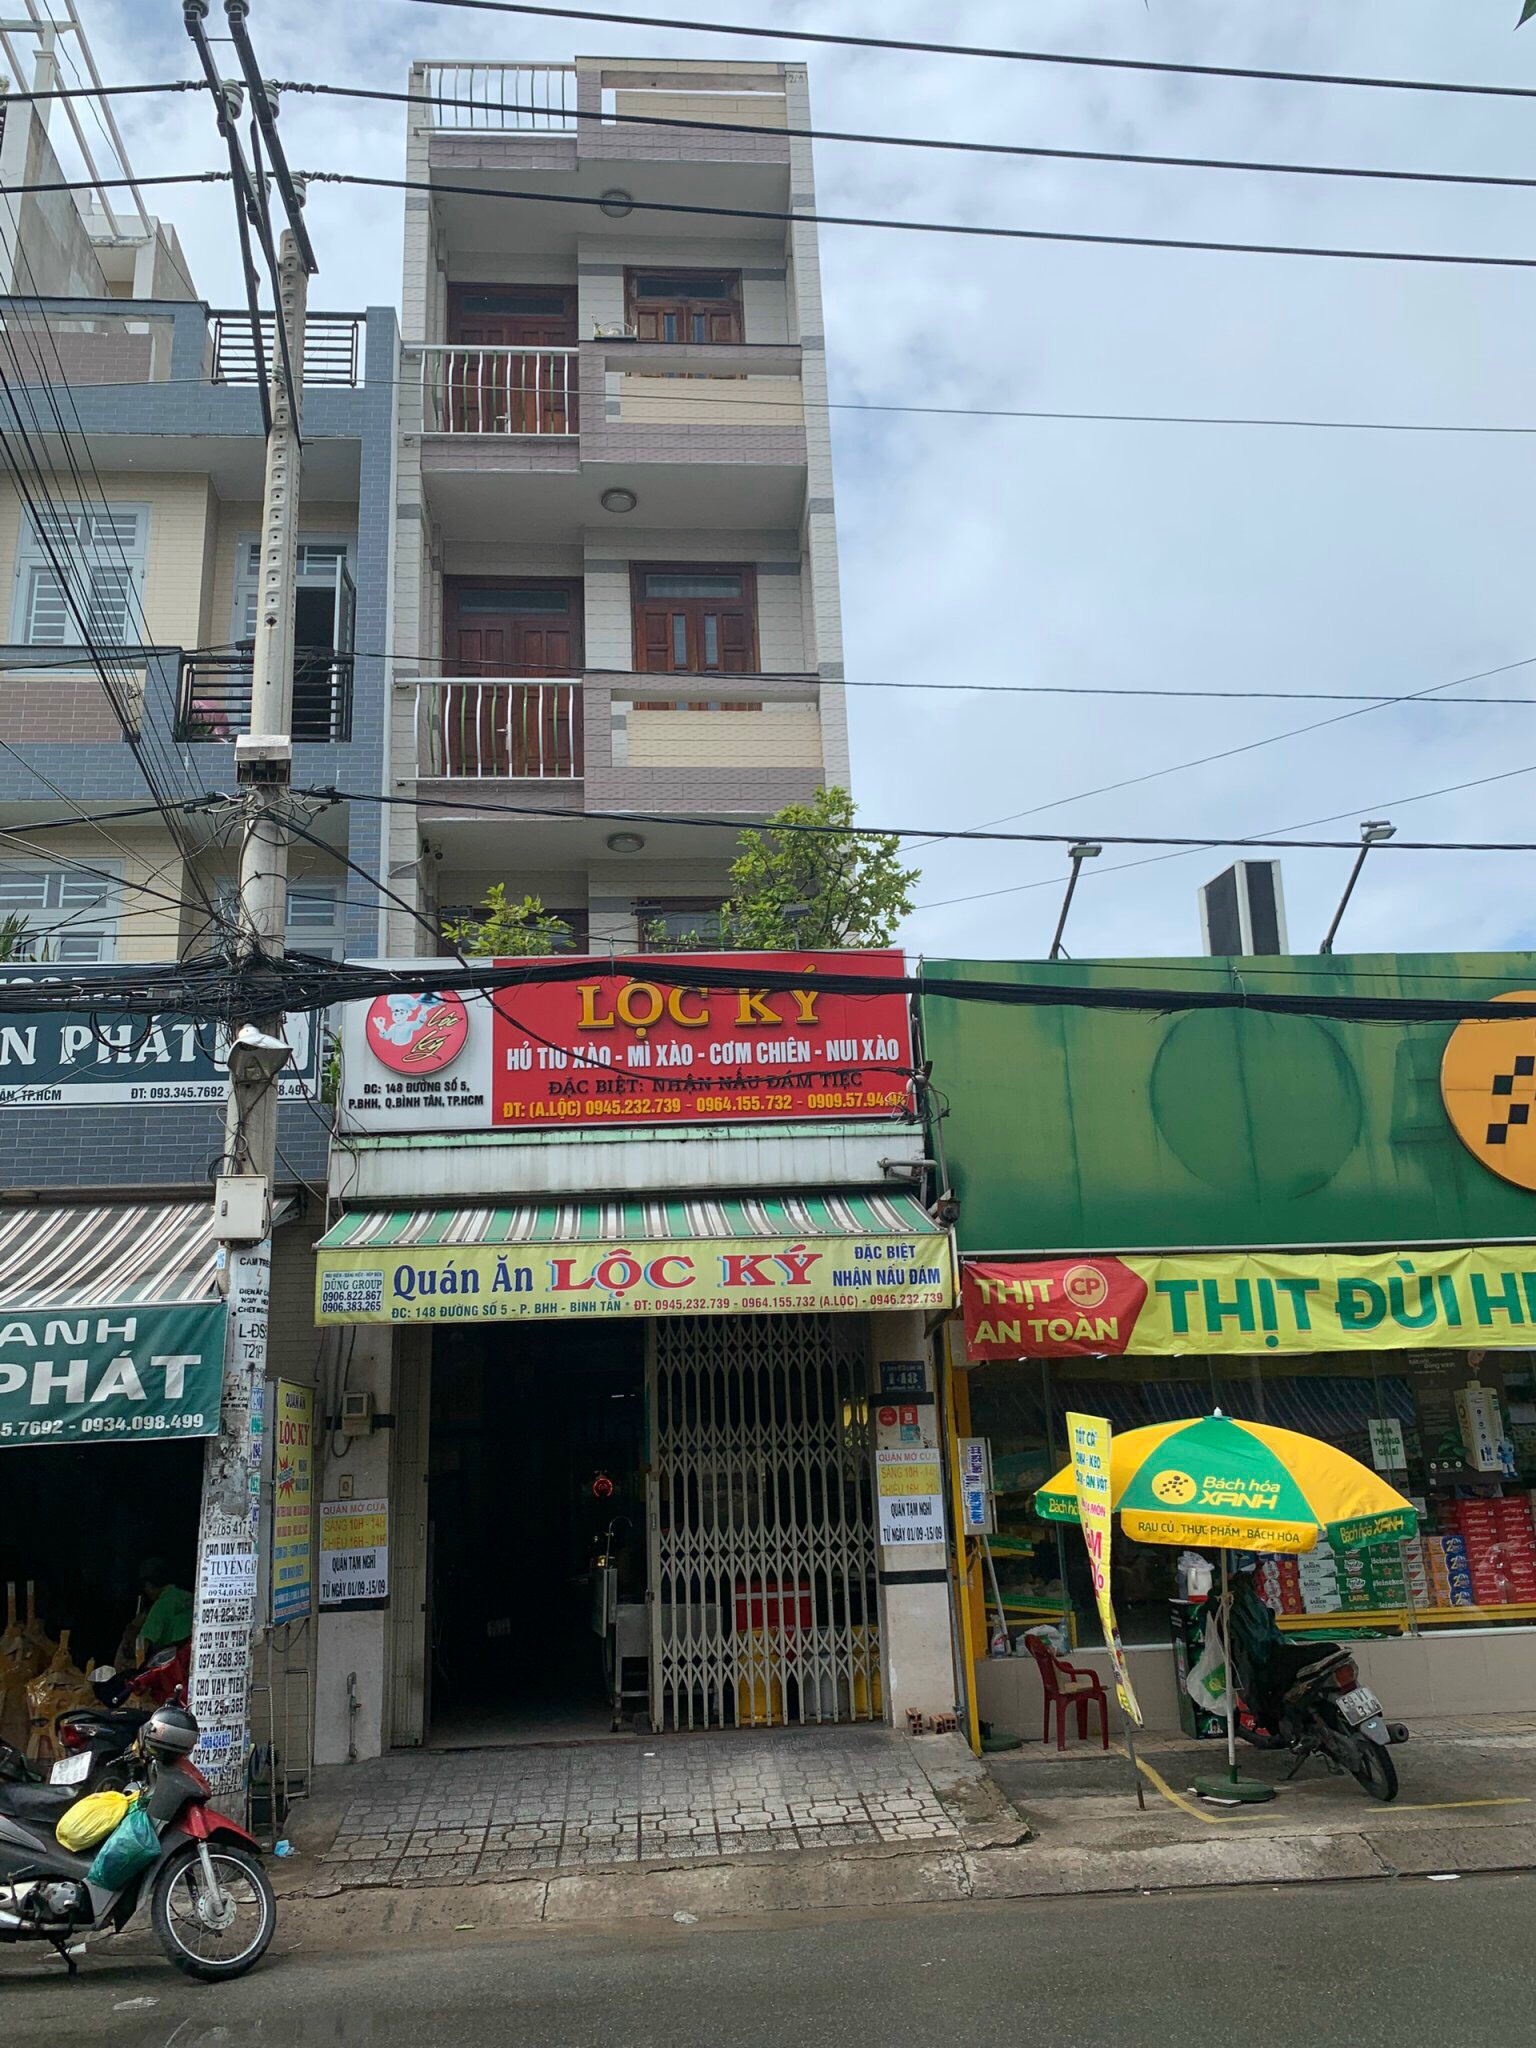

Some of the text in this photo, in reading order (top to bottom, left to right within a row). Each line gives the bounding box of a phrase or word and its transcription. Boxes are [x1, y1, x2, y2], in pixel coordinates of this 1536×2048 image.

[576, 964, 819, 1039] LỘC KÝ
[507, 1041, 532, 1071] HỦ
[572, 1041, 611, 1068] XÀO
[628, 1041, 650, 1067] MÌ
[656, 1039, 693, 1066] XÀO
[710, 1039, 752, 1065] CƠM
[757, 1036, 811, 1063] CHIÊN
[826, 1039, 859, 1062] NUI
[862, 1034, 899, 1061] XÀO
[21, 1089, 62, 1102] TP.HCM
[131, 1085, 224, 1100] ĐT: 093.345.7692
[385, 1082, 403, 1095] 148
[548, 1078, 588, 1098] ĐẶC
[446, 1093, 484, 1107] TP.HCM
[503, 1091, 907, 1121] ĐT: (A.LỘC) 0945.232.739 0964.155.732 0909.57.94.9
[854, 1242, 917, 1263] ĐẶC BIỆT
[392, 1243, 824, 1301] Quán Ăn LỘC KÝ
[832, 1262, 941, 1290] NHẬN NẤU ĐÁM
[352, 1279, 383, 1290] GROUP
[974, 1278, 1054, 1311] THỊT
[1070, 1277, 1100, 1296] CP
[323, 1290, 382, 1302] 0906.822.867
[391, 1307, 411, 1319] ĐC:
[415, 1306, 436, 1318] 148
[439, 1303, 479, 1318] ĐƯỜNG
[482, 1300, 497, 1316] SỐ
[500, 1304, 508, 1316] 5
[534, 1302, 558, 1314] BHH
[569, 1298, 597, 1313] BÌNH
[599, 1297, 622, 1312] TÂN
[633, 1299, 652, 1312] ĐT:
[655, 1297, 730, 1311] 0945.232.739
[741, 1295, 816, 1309] 0964.155.732
[819, 1293, 859, 1309] (A.LỘC)
[870, 1292, 944, 1306] 0946.232.739
[1155, 1277, 1320, 1349] THỊT
[1334, 1258, 1463, 1334] ĐÙI
[322, 1300, 382, 1313] 0906.383.265
[974, 1311, 1120, 1344] AN TOÀN
[81, 1413, 204, 1433] 0934.098.499
[1203, 1475, 1281, 1493] Bách hóa
[890, 1499, 906, 1519] QUÁN
[906, 1502, 919, 1518] TẠM
[1048, 1497, 1068, 1514] Bách
[1068, 1498, 1080, 1515] hó
[1197, 1489, 1278, 1510] XANH
[907, 1526, 923, 1541] 01/09
[1138, 1520, 1300, 1543] RAU CỦ THỰC PHẨM BÁCH HÓA
[1339, 1523, 1359, 1544] Bách
[1373, 1514, 1405, 1535] XANH
[332, 1553, 348, 1574] QUÁN
[349, 1555, 361, 1573] TẠM
[347, 1580, 365, 1596] 01/09
[199, 1650, 246, 1669] 0974.298.365
[196, 1677, 227, 1697] CHO VAY
